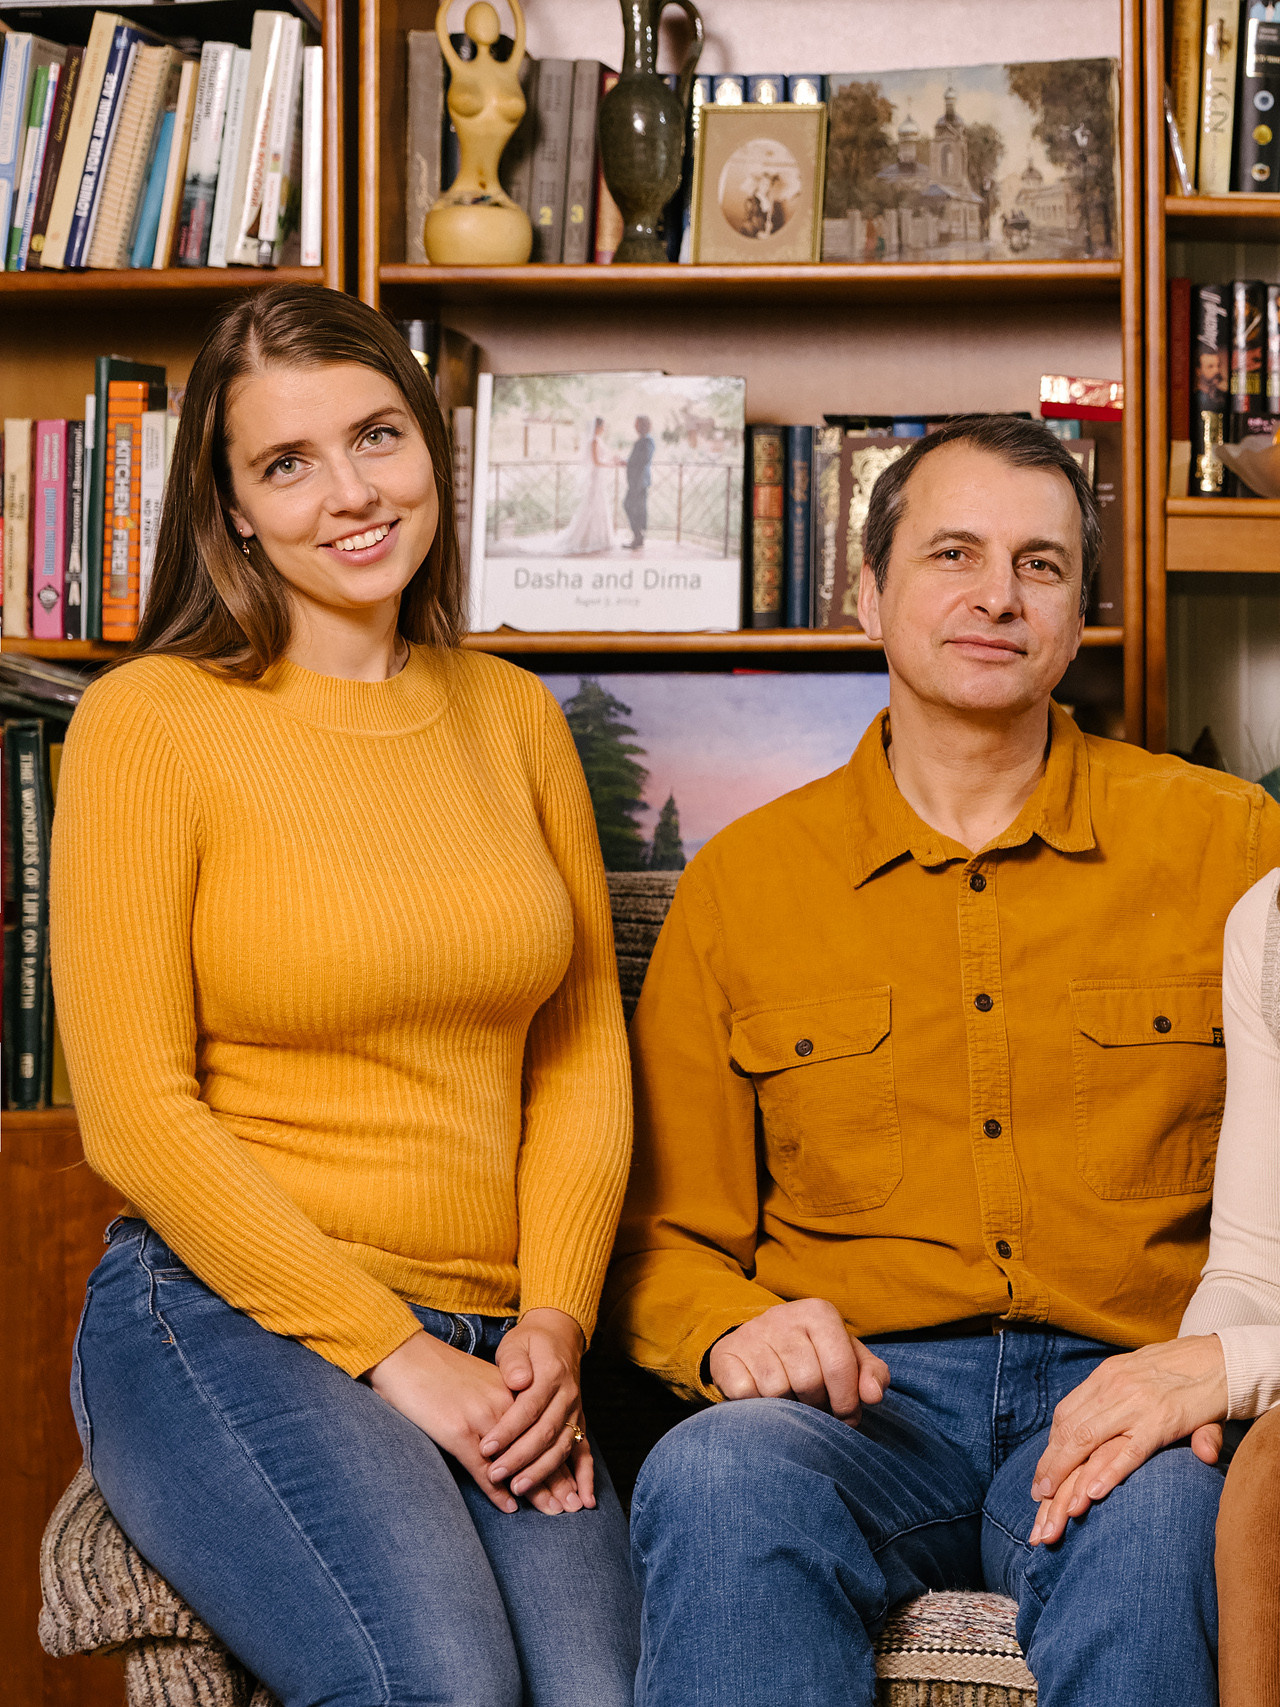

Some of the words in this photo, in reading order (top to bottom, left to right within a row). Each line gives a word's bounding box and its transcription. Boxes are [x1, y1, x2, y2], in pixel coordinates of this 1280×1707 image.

[101, 72, 120, 100] AGE
[92, 98, 114, 139] BRAIN
[84, 137, 105, 174] YOUR
[75, 172, 97, 218] LOWER
[539, 206, 553, 225] 2
[571, 204, 585, 224] 3
[115, 440, 131, 515] KITCHEN
[112, 530, 128, 575] FIRE!
[514, 567, 583, 589] Dasha
[592, 568, 633, 589] and
[643, 567, 701, 589] Dima
[20, 752, 34, 784] THE
[21, 789, 39, 865] WONDERS
[22, 868, 40, 890] OF
[22, 893, 38, 926] LIFE
[22, 930, 38, 953] ON
[21, 957, 36, 1009] EARTH
